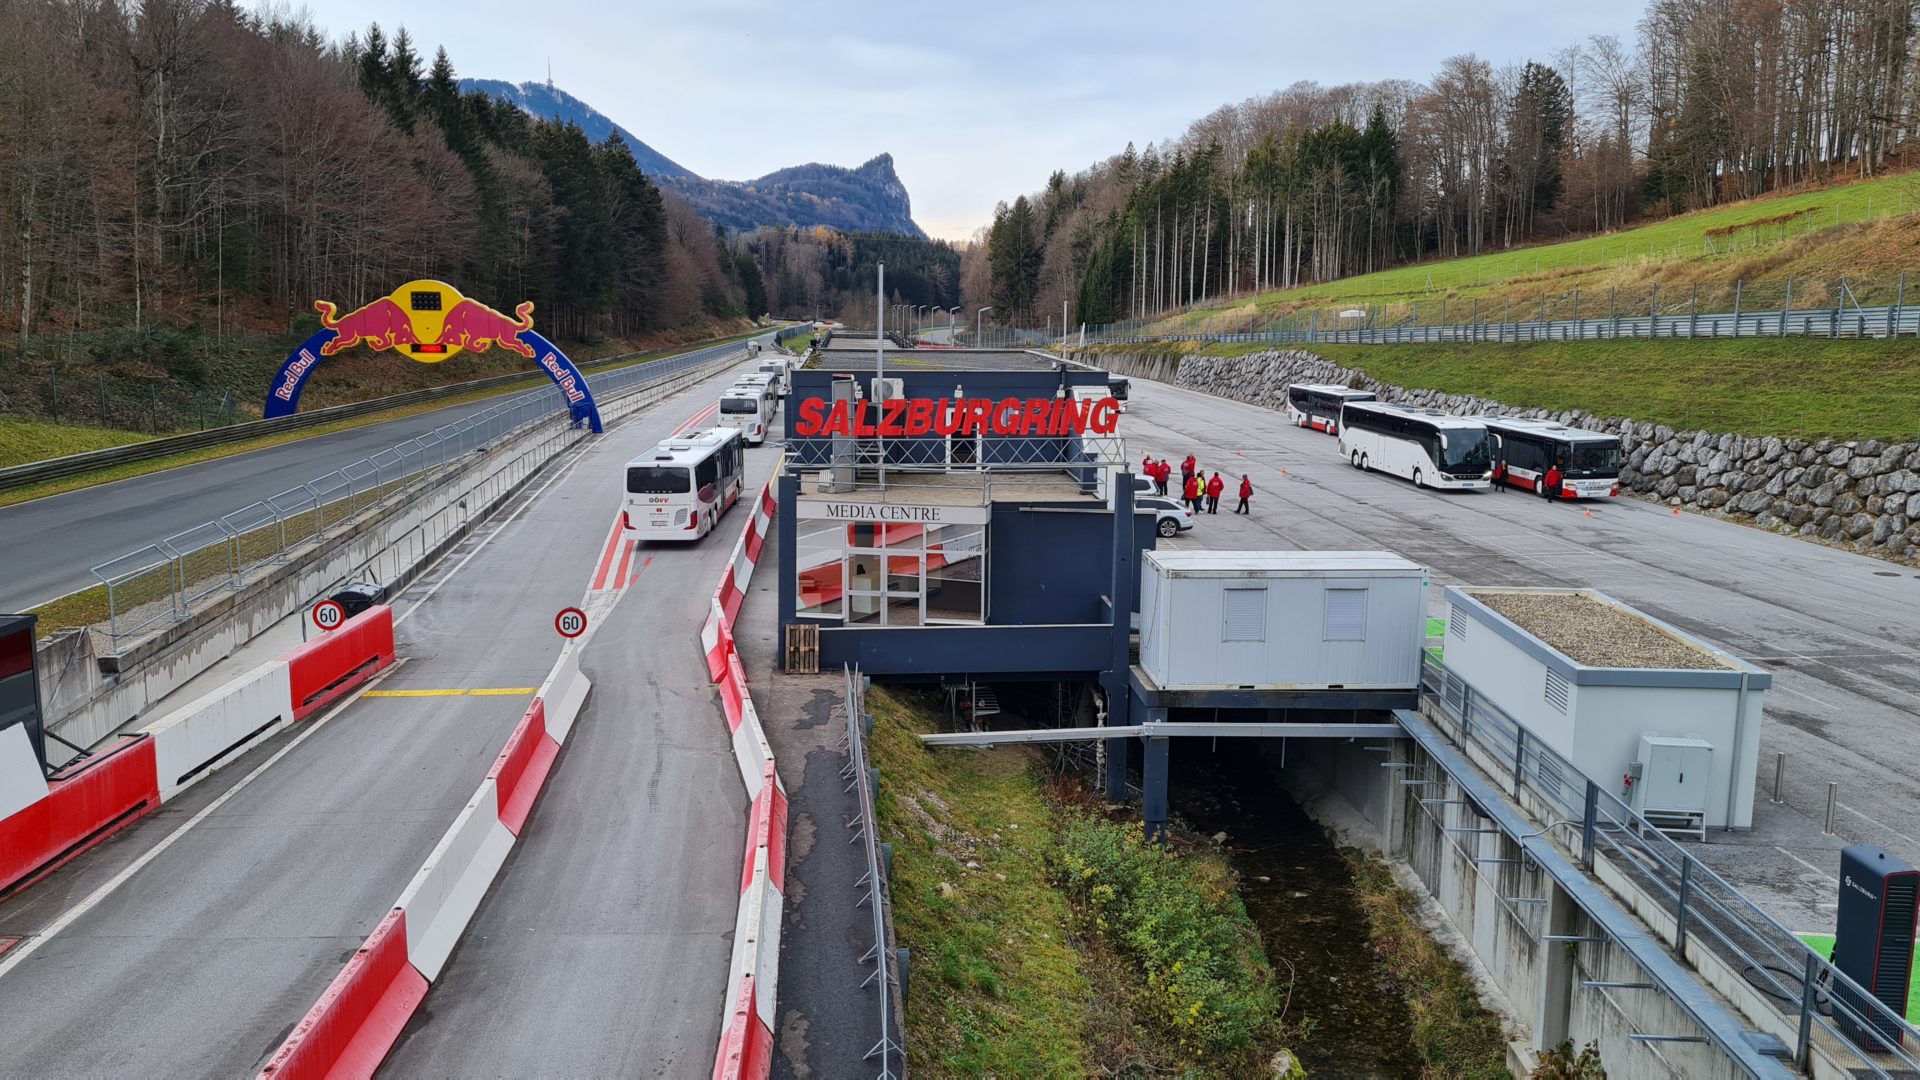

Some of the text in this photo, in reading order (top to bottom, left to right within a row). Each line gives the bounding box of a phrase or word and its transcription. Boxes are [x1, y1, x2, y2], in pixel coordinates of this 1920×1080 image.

[275, 348, 316, 400] Red Bull
[541, 351, 585, 403] Red Bull
[796, 397, 1119, 437] SALZBURGRING
[826, 504, 941, 521] MEDIA CENTRE
[320, 607, 337, 623] 60
[562, 616, 579, 630] 60
